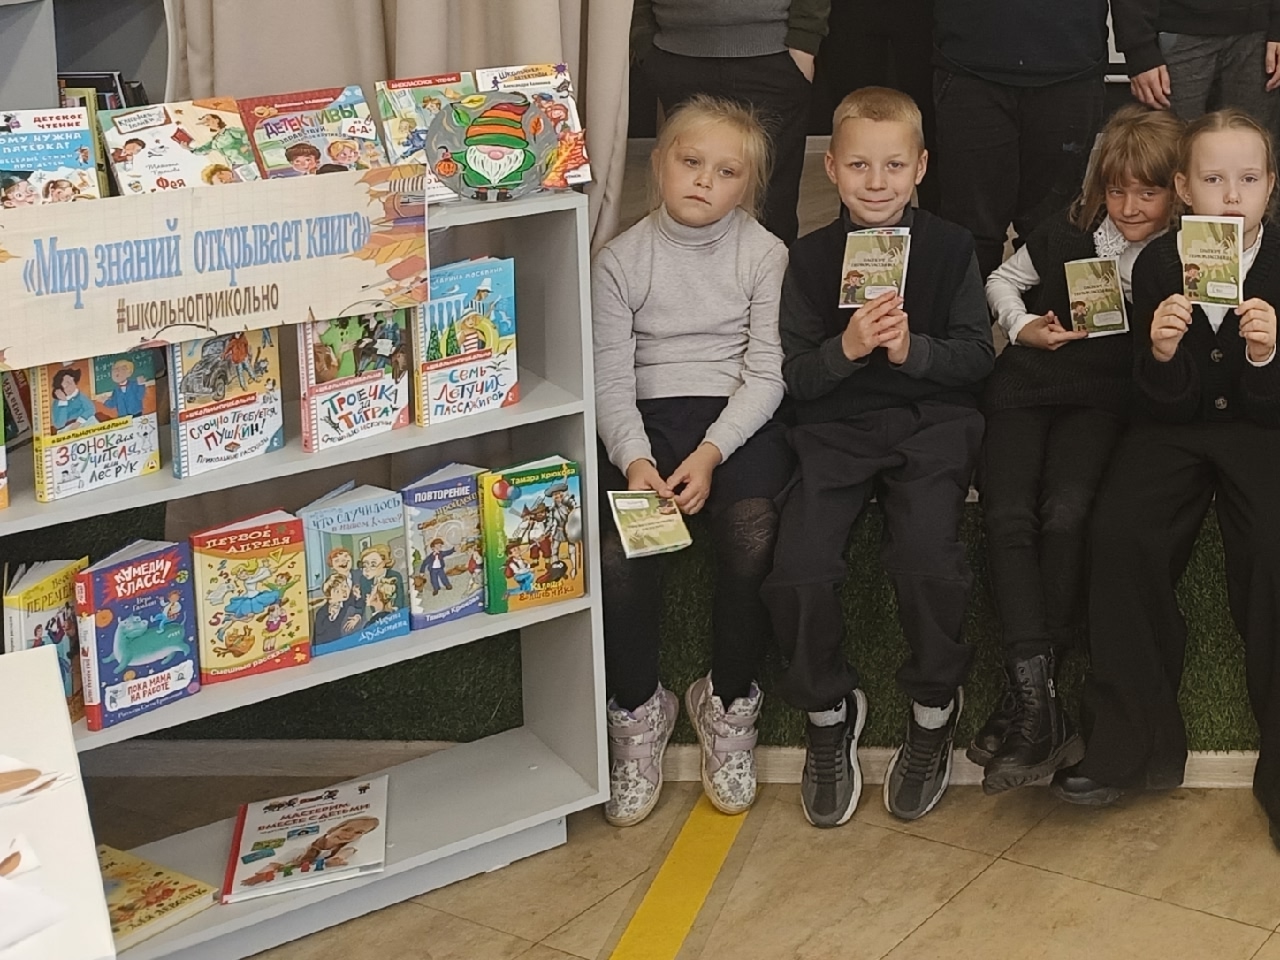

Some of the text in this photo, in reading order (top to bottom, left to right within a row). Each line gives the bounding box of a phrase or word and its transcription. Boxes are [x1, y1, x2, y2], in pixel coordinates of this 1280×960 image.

[33, 114, 82, 123] ДЕТСКОЕ
[264, 103, 359, 139] ДЕТЕКТИВЫ
[33, 132, 82, 142] НУЖНА
[23, 211, 371, 309] «Мир знаний открывает книга»
[414, 485, 471, 503] ПОВТОРЕНИЕ
[336, 497, 401, 524] СЛУЧИЛОСЬ
[206, 530, 271, 549] ПЕРВОЕ
[225, 536, 291, 554] АПРЕЛЯ
[128, 672, 172, 694] ПОКА МАМА
[279, 802, 350, 820] МАСТЕРИМ
[257, 817, 307, 832] ВМЕСТЕ
